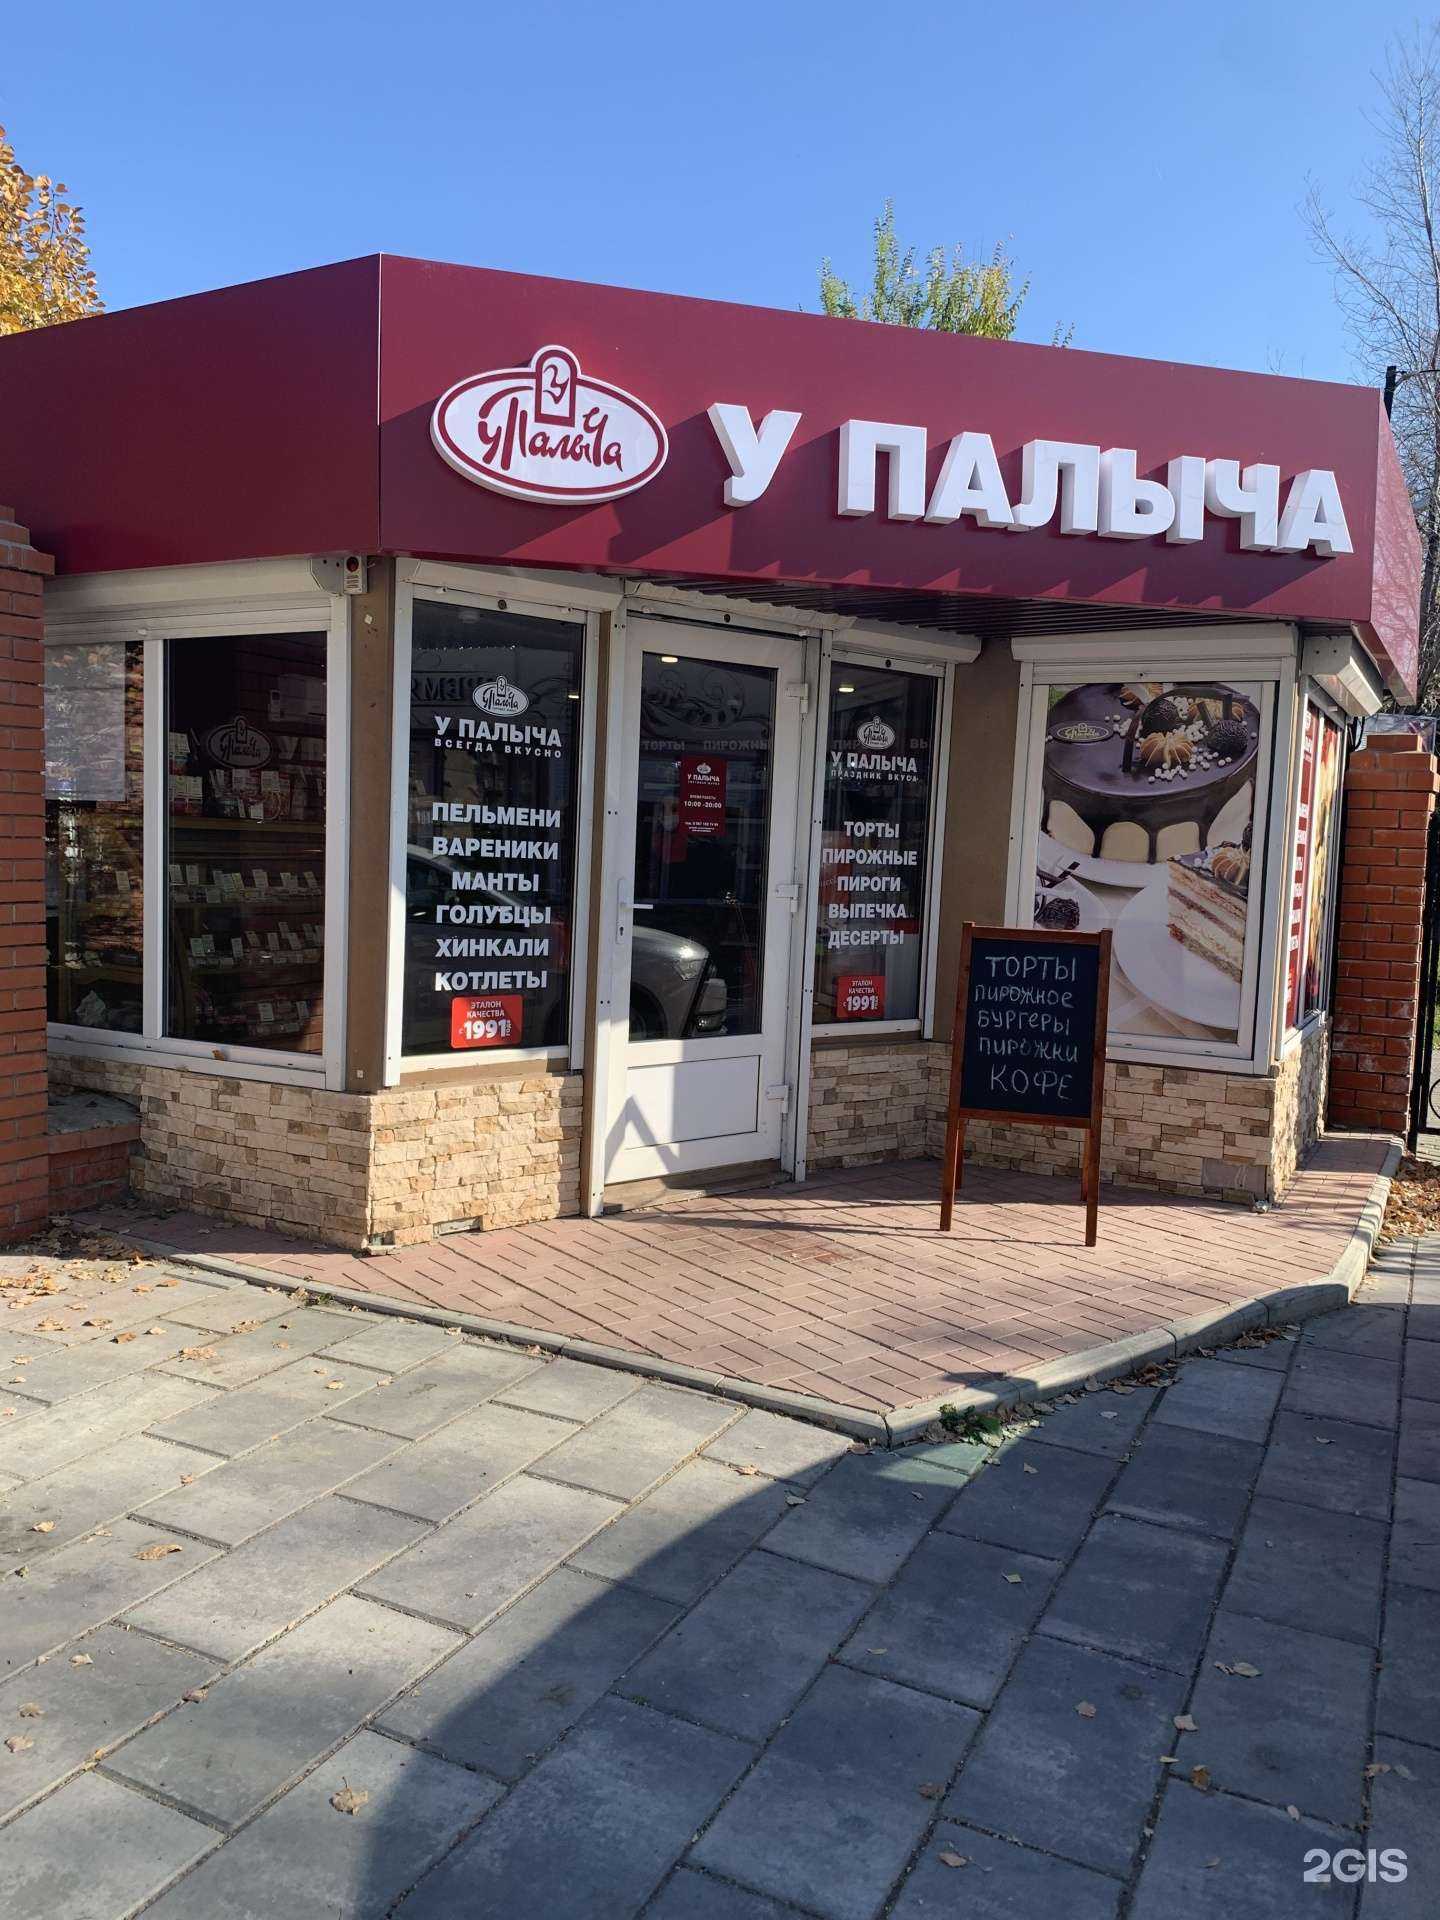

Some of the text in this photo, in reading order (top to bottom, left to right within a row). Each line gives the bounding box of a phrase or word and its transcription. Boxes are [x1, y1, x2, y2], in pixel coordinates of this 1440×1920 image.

[706, 403, 1354, 558] У ПАЛЫЧА
[433, 715, 562, 747] У ПАЛЫЧА
[434, 738, 562, 759] ВСЕГДА ВКУСНО
[830, 750, 918, 773] У ПАЛЫЧА
[830, 769, 882, 780] ПРАЗДНИК
[432, 802, 560, 828] ПЕЛЬМЕНИ
[843, 821, 900, 838] ТОРТЫ
[432, 836, 559, 860] ВАРЕНИКИ
[822, 848, 918, 866] ПИРОЖНЫЕ
[451, 871, 539, 892] МАНТЫ
[837, 876, 901, 892] ПИРОГИ
[436, 904, 551, 928] ГОЛУБЦЫ
[828, 903, 907, 919] ВЫПЕЧКА
[435, 938, 549, 957] ХИНКАЛИ
[827, 930, 905, 949] ДЕСЕРТЫ
[984, 956, 1077, 982] ТОРТЫ
[434, 970, 548, 991] КОТЛЕТЫ
[465, 1009, 505, 1018] КАЧЕСТВА
[470, 1000, 502, 1009] ЭТАЛОН
[846, 995, 876, 1011] 1991
[463, 1018, 506, 1040] 1991
[989, 1063, 1073, 1100] КОФЕ
